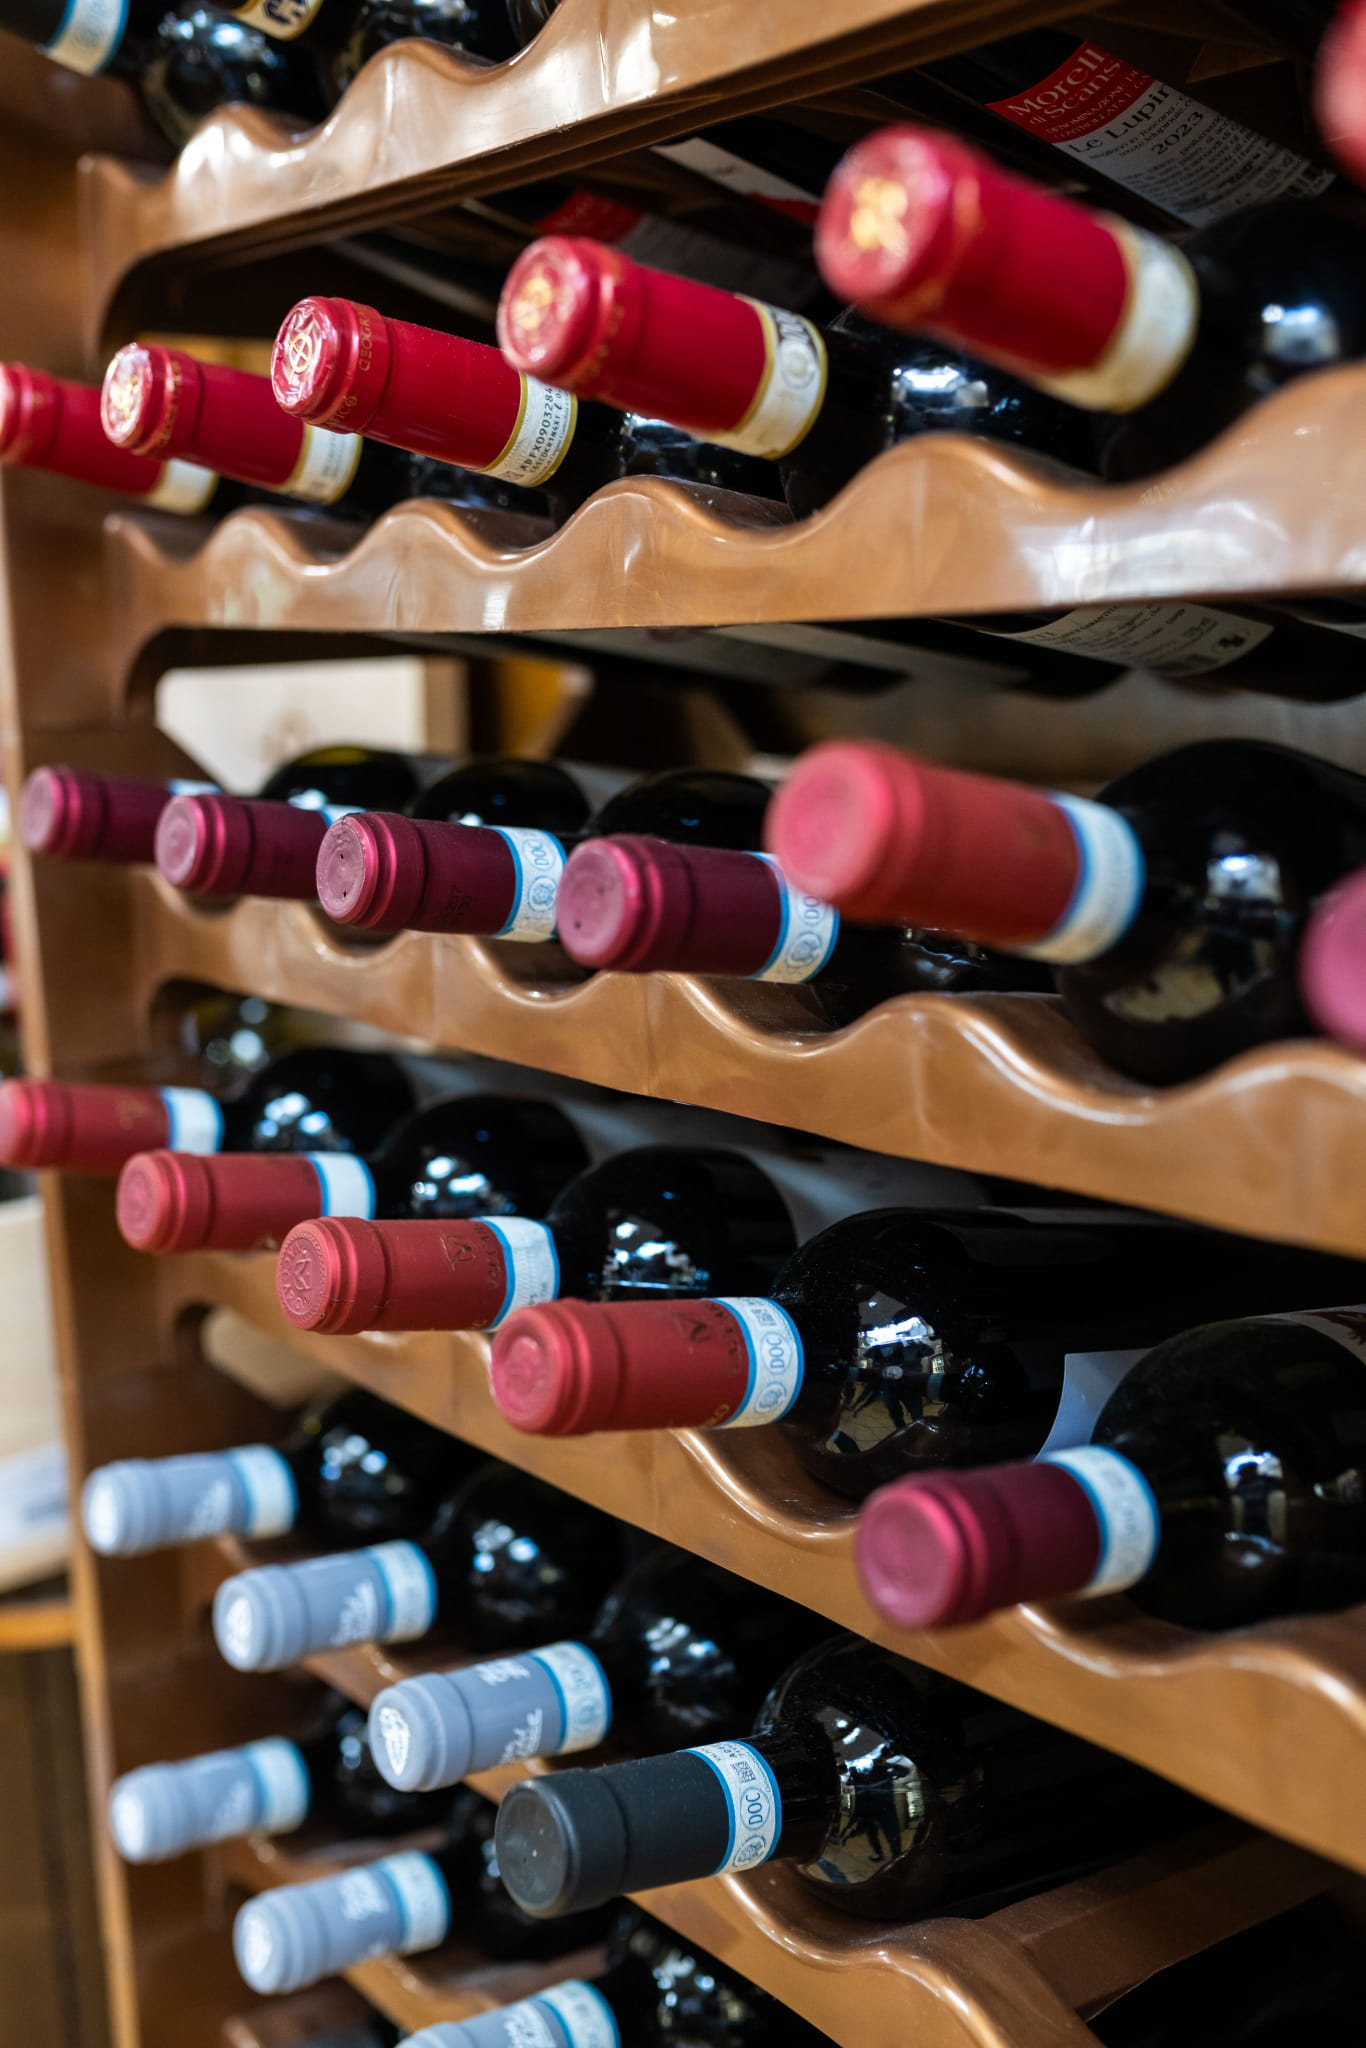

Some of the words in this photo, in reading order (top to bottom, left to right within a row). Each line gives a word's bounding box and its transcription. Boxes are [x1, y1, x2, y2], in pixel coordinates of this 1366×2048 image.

[1029, 115, 1047, 125] di
[1043, 62, 1121, 119] Scans
[1068, 139, 1104, 153] Le
[1151, 111, 1205, 156] 2023
[528, 842, 550, 866] DOC
[803, 895, 820, 919] DO
[766, 1336, 785, 1370] DOC
[745, 1791, 764, 1826] DOC
